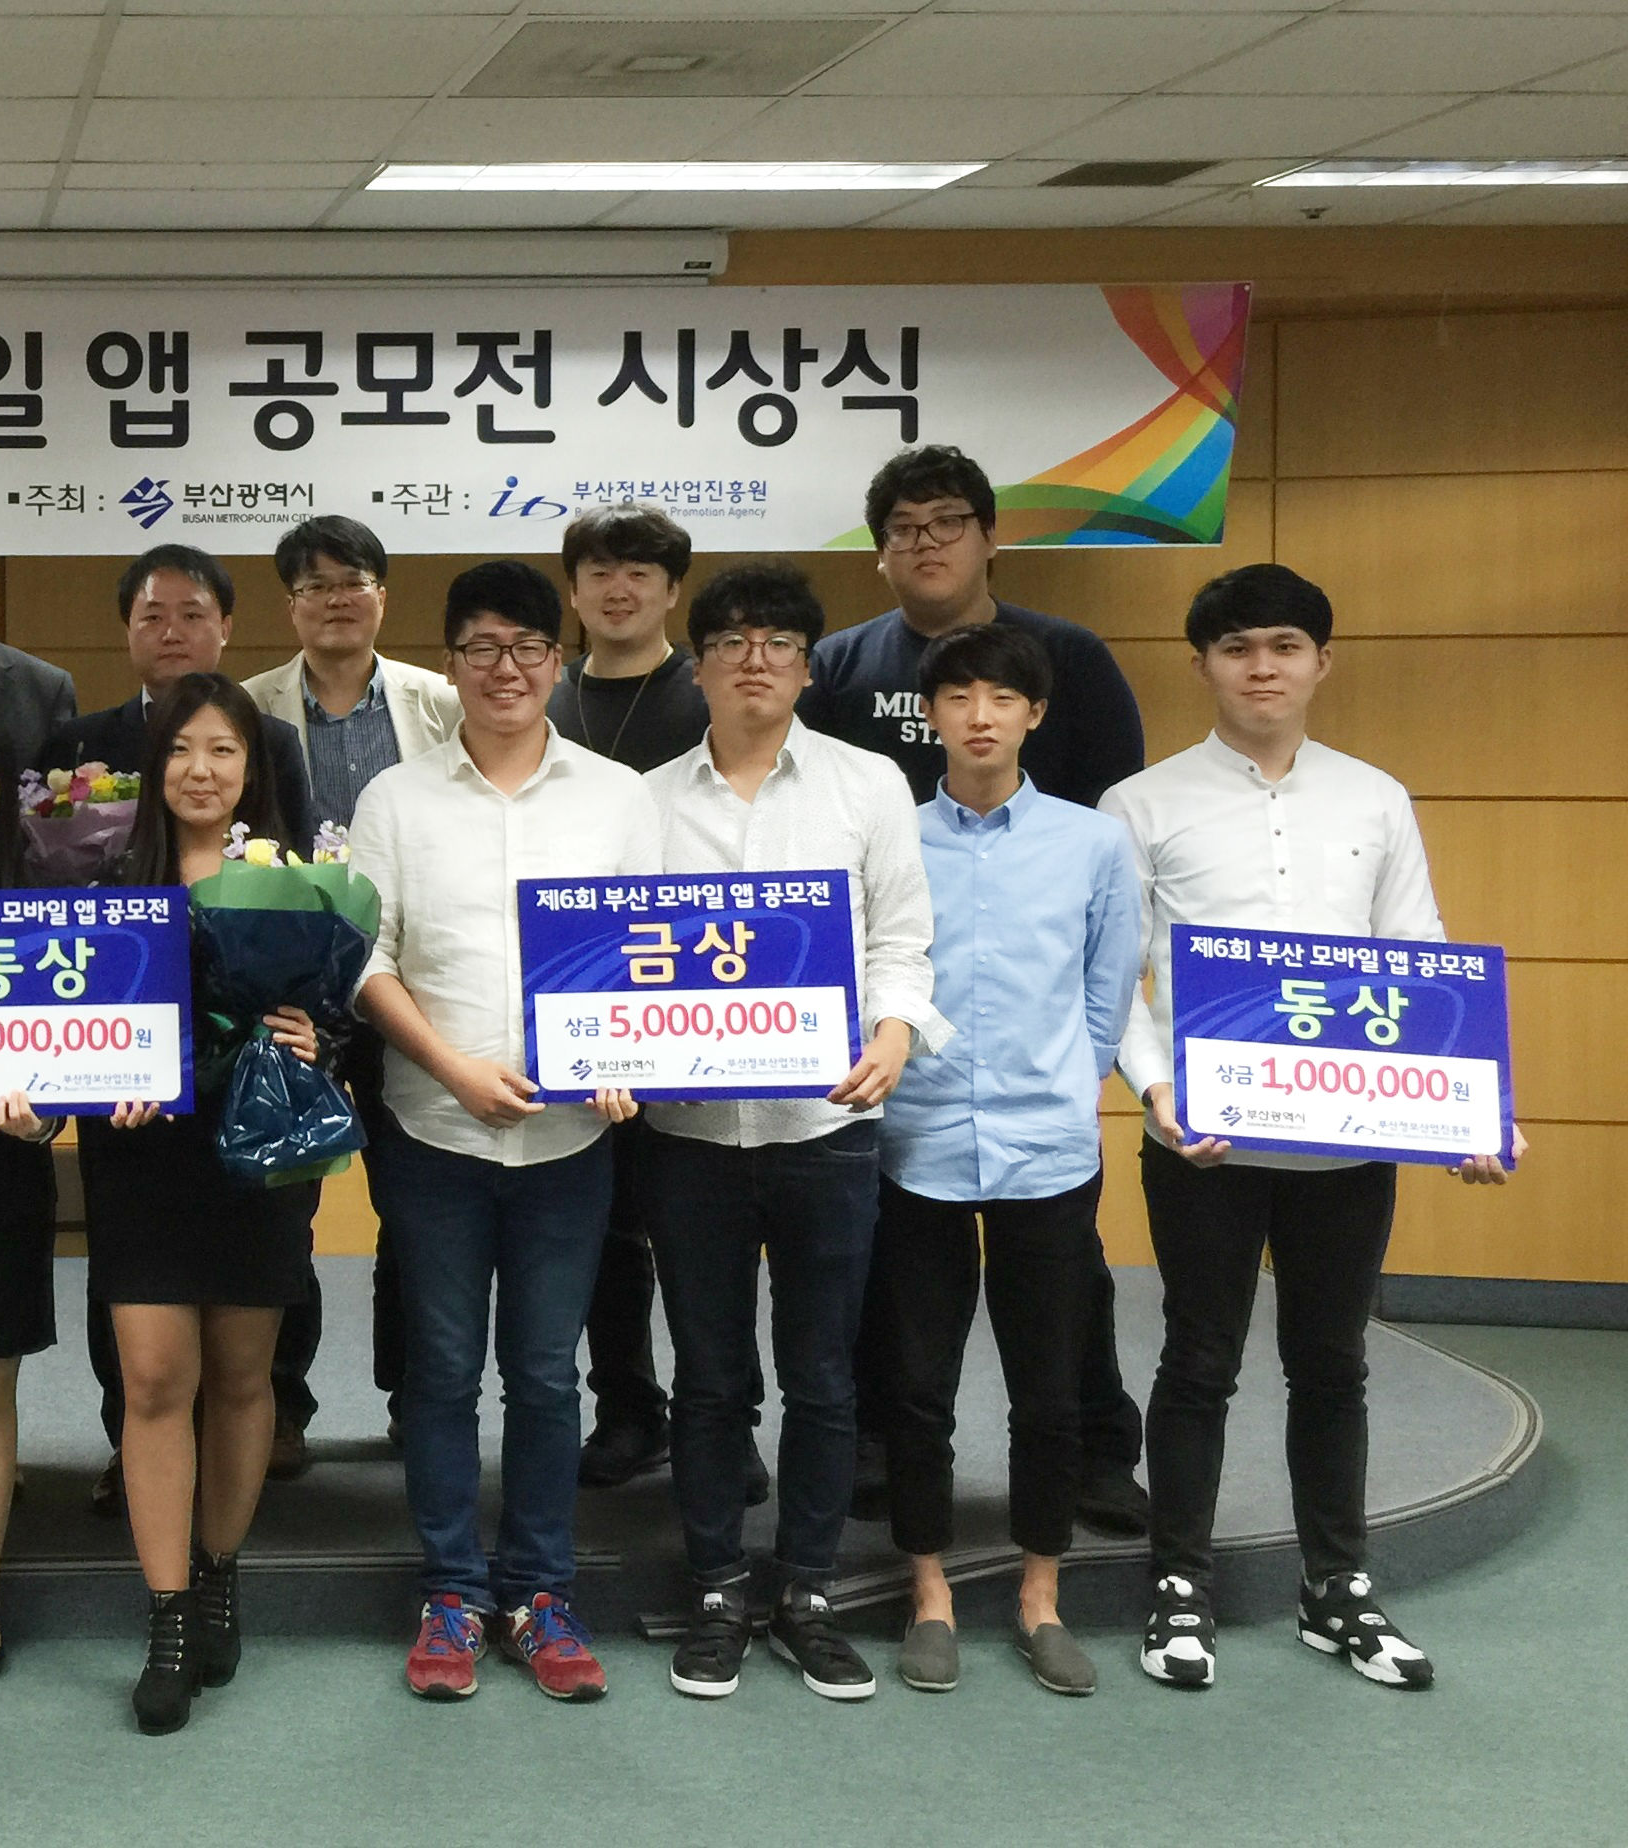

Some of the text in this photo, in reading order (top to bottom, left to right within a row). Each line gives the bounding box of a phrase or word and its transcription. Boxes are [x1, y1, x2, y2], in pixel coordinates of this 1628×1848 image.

[85, 329, 191, 450] 앱
[229, 328, 557, 452] 공모전
[597, 325, 921, 448] 시상식
[183, 482, 314, 509] 부산광역시
[572, 480, 767, 504] 부산정보산업진흥원
[182, 513, 215, 524] BUSAN
[216, 513, 289, 524] METROPOLITAN
[671, 507, 767, 519] Promotion Agency
[536, 881, 831, 913] 제6회 부산 모바일 앱 공모전
[0, 899, 68, 925] 모바일
[74, 899, 96, 925] 앱
[102, 898, 170, 925] 공모전
[1190, 936, 1486, 981] 제6회 부산 모바일 앱 공모전
[565, 1017, 600, 1038] 상금
[597, 1059, 655, 1071] 부산광역시
[1215, 1064, 1254, 1085] 상금
[1247, 1108, 1306, 1123] 부산광역시
